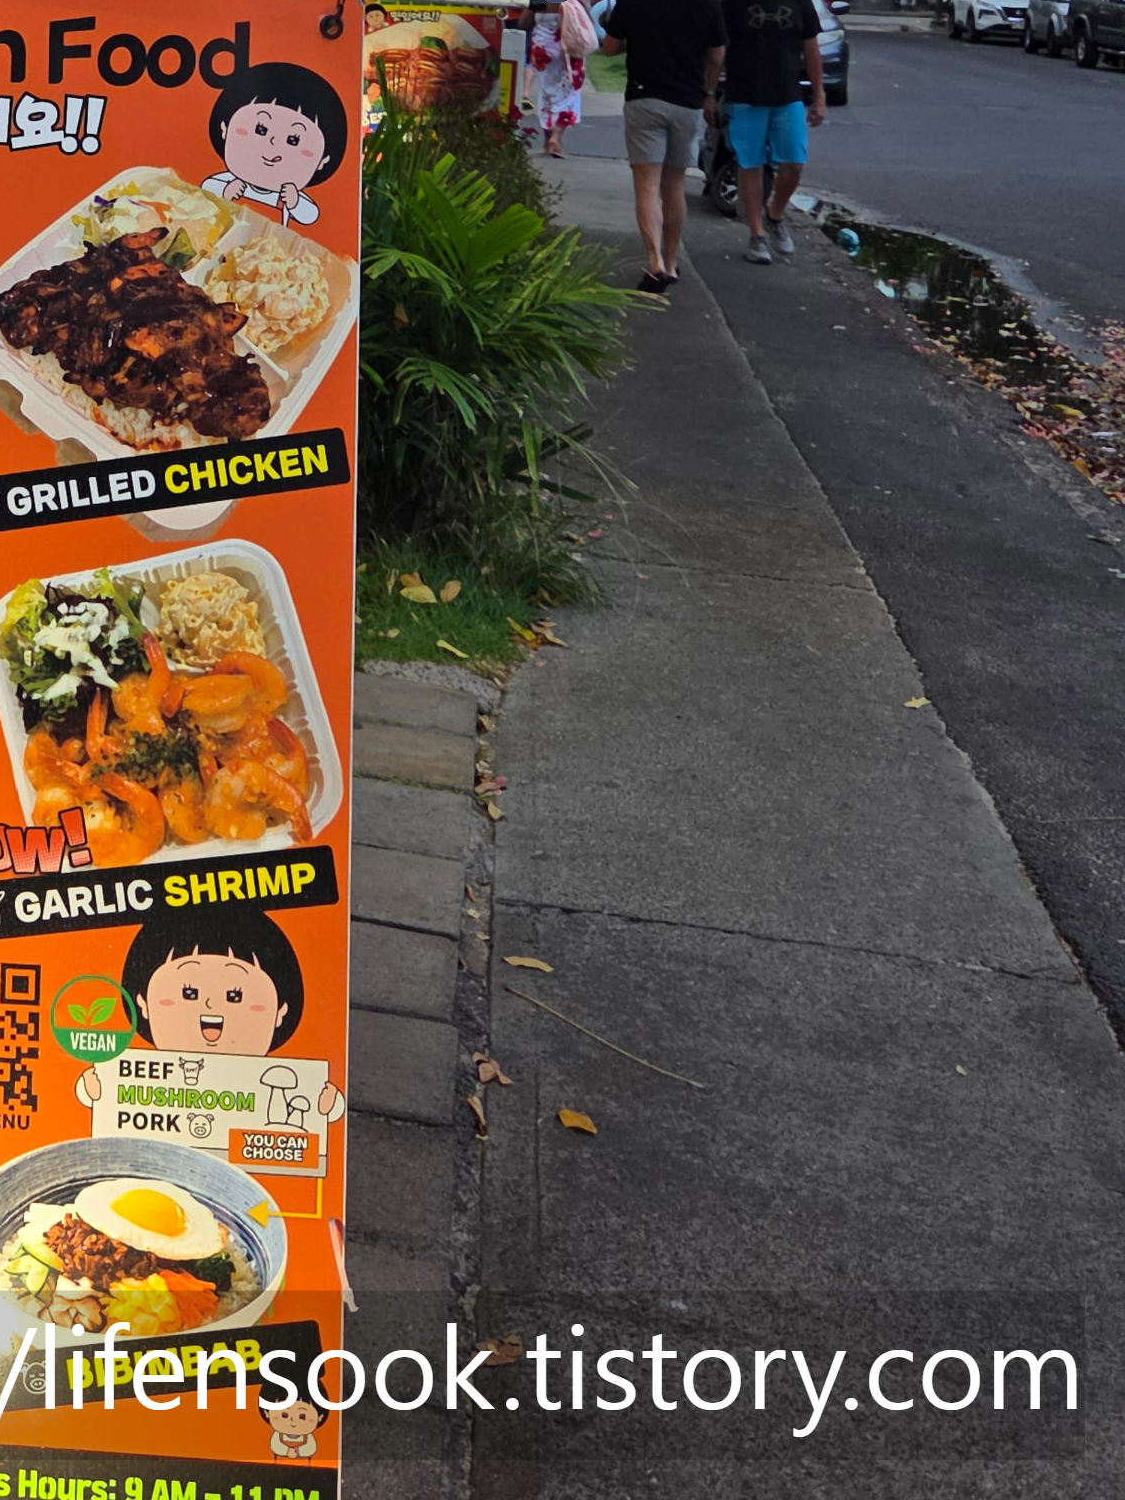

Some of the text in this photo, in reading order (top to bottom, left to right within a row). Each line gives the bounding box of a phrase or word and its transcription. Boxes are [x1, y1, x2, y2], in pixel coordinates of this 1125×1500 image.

[47, 15, 253, 89] Food
[6, 445, 330, 517] GRILLED CHICKEN
[14, 861, 318, 923] GARLIC SHRIMP
[70, 1031, 117, 1053] VEGAN
[118, 1059, 175, 1080] BEEF
[117, 1084, 256, 1112] MUSHROOM
[117, 1111, 181, 1132] PORK
[242, 1145, 304, 1162] CHOOSE
[243, 1132, 308, 1150] YOU CAN
[66, 1338, 263, 1390] BIBIMBAB
[19, 1468, 117, 1500] Hours:
[125, 1476, 143, 1500] 9
[152, 1479, 197, 1500] AM
